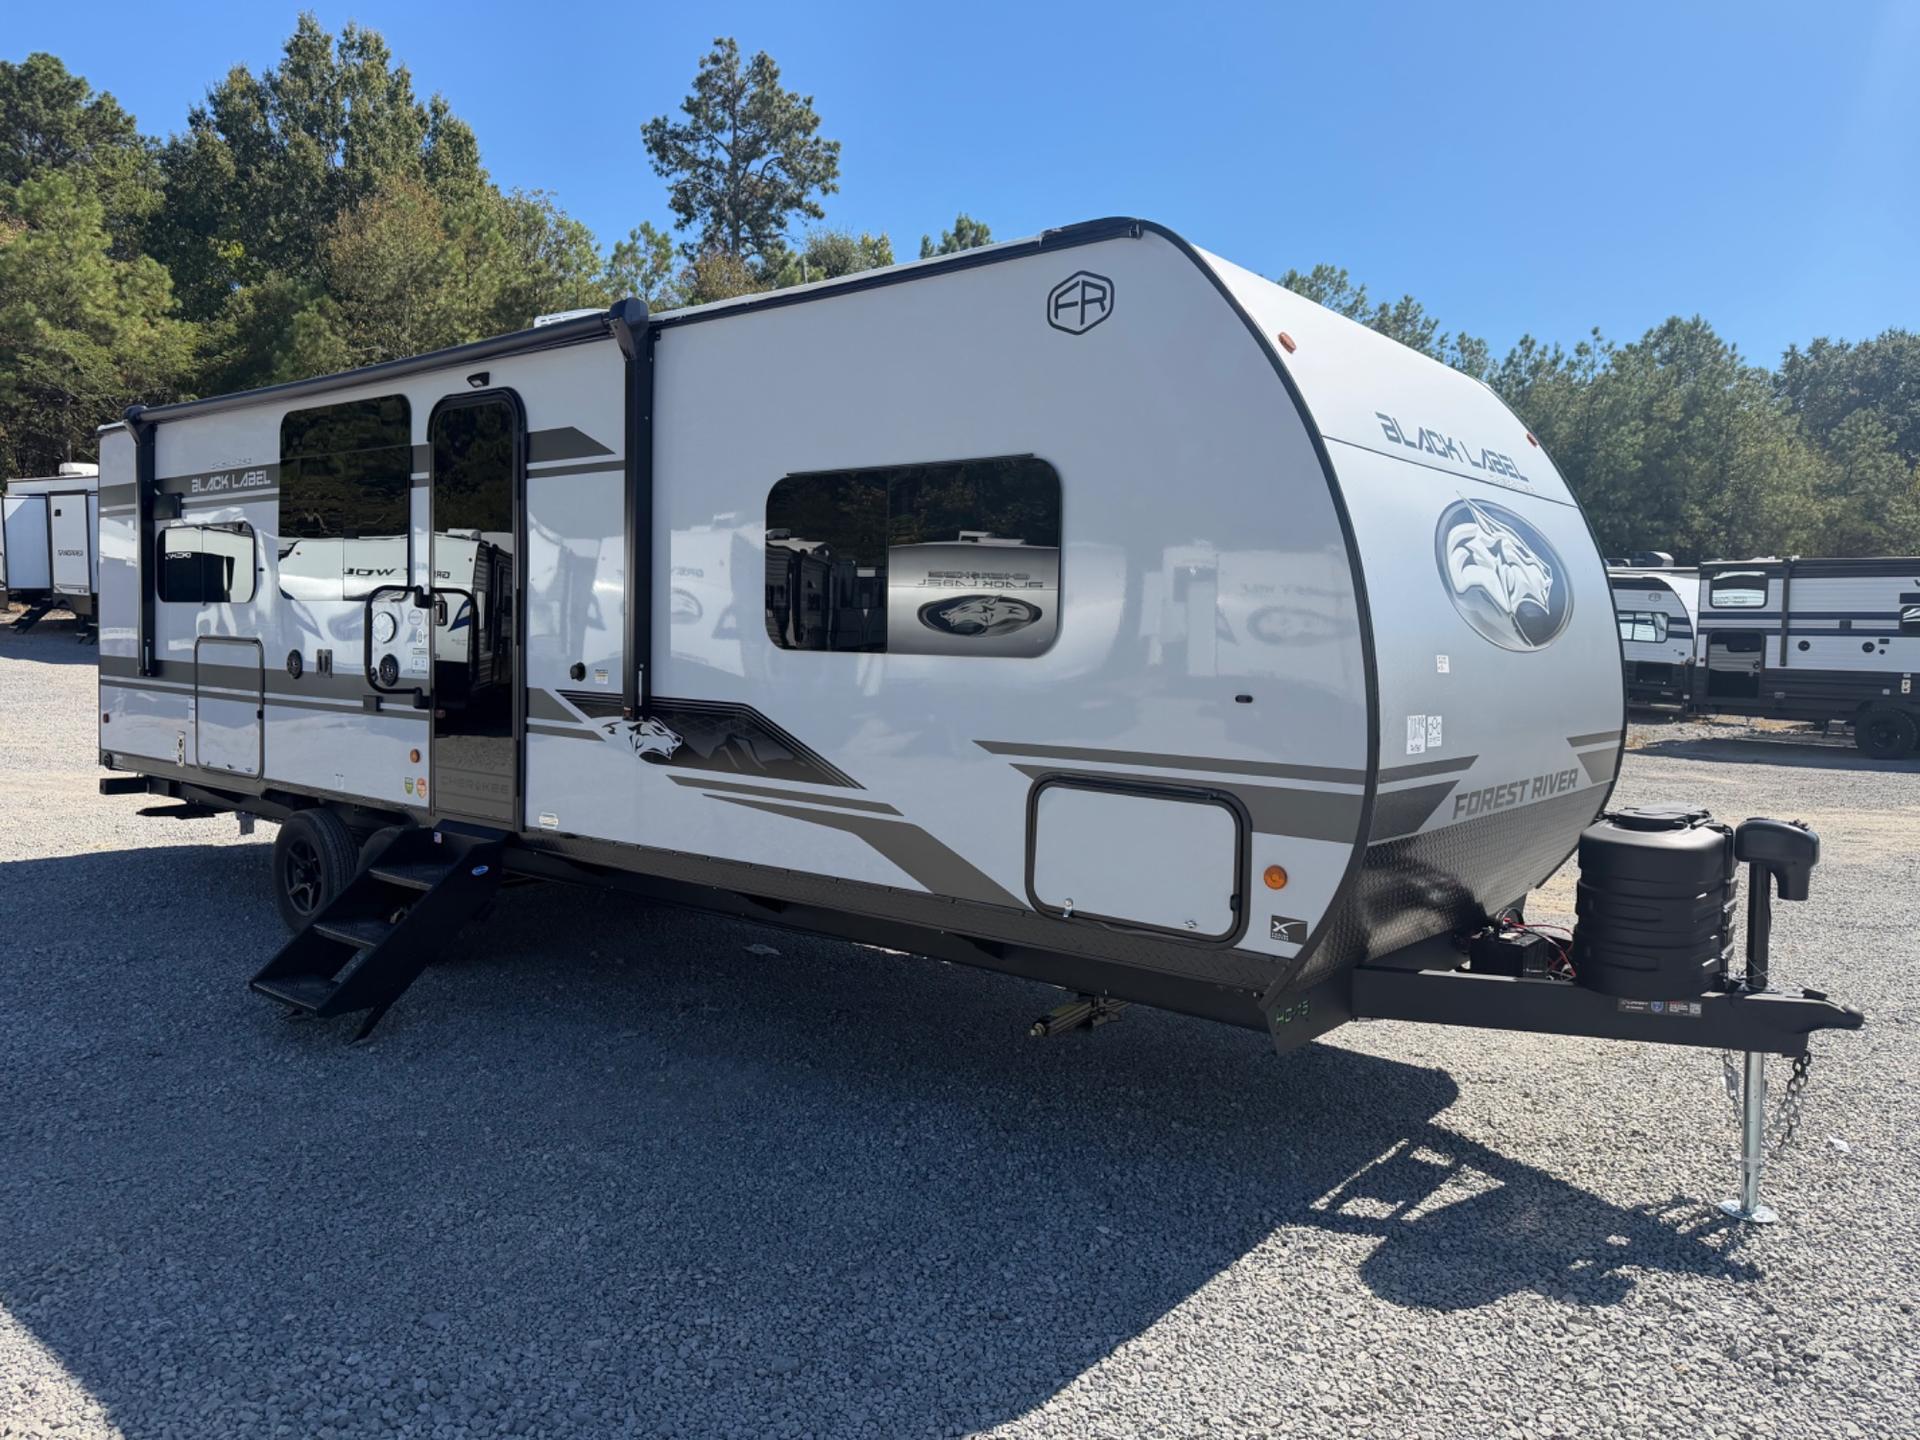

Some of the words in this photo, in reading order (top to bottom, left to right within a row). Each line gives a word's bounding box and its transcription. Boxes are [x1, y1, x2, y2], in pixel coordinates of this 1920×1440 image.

[1054, 280, 1107, 326] FR
[1375, 411, 1464, 463] BLACK
[1459, 440, 1530, 483] LABEL
[191, 474, 230, 493] BLACK
[231, 470, 272, 489] LABEL
[1452, 778, 1531, 820] FOREST
[1530, 767, 1579, 800] RIVER
